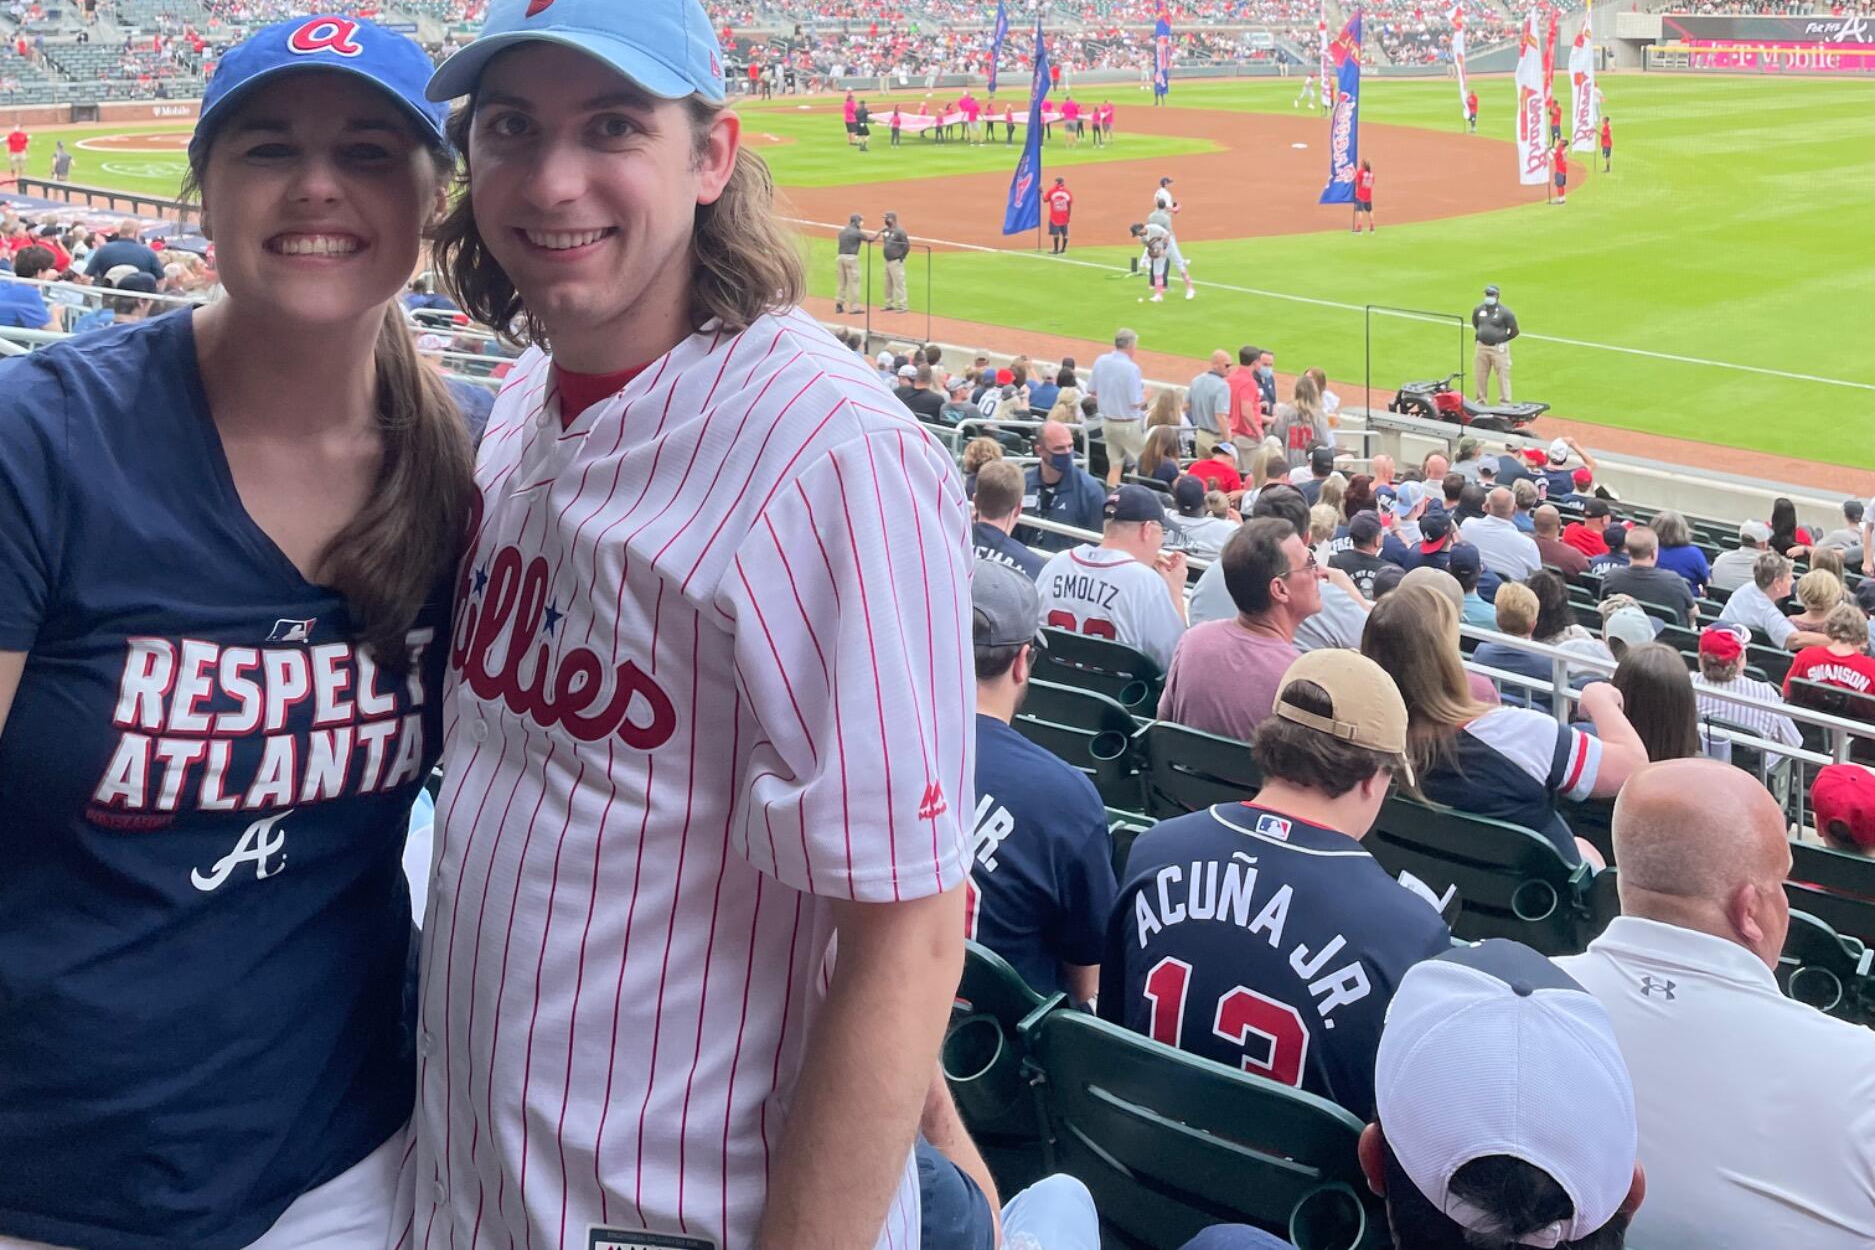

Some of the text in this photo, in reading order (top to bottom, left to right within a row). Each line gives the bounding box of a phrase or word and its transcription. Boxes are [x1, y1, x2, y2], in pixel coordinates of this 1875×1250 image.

[1805, 22, 1824, 34] FOR
[1052, 574, 1120, 611] SMOLTZ
[1807, 663, 1871, 692] SWANSON
[92, 712, 426, 812] ATLANTA
[1135, 851, 1294, 950] ACUÑA
[1143, 955, 1311, 1090] 13
[1289, 933, 1372, 1030] JR.
